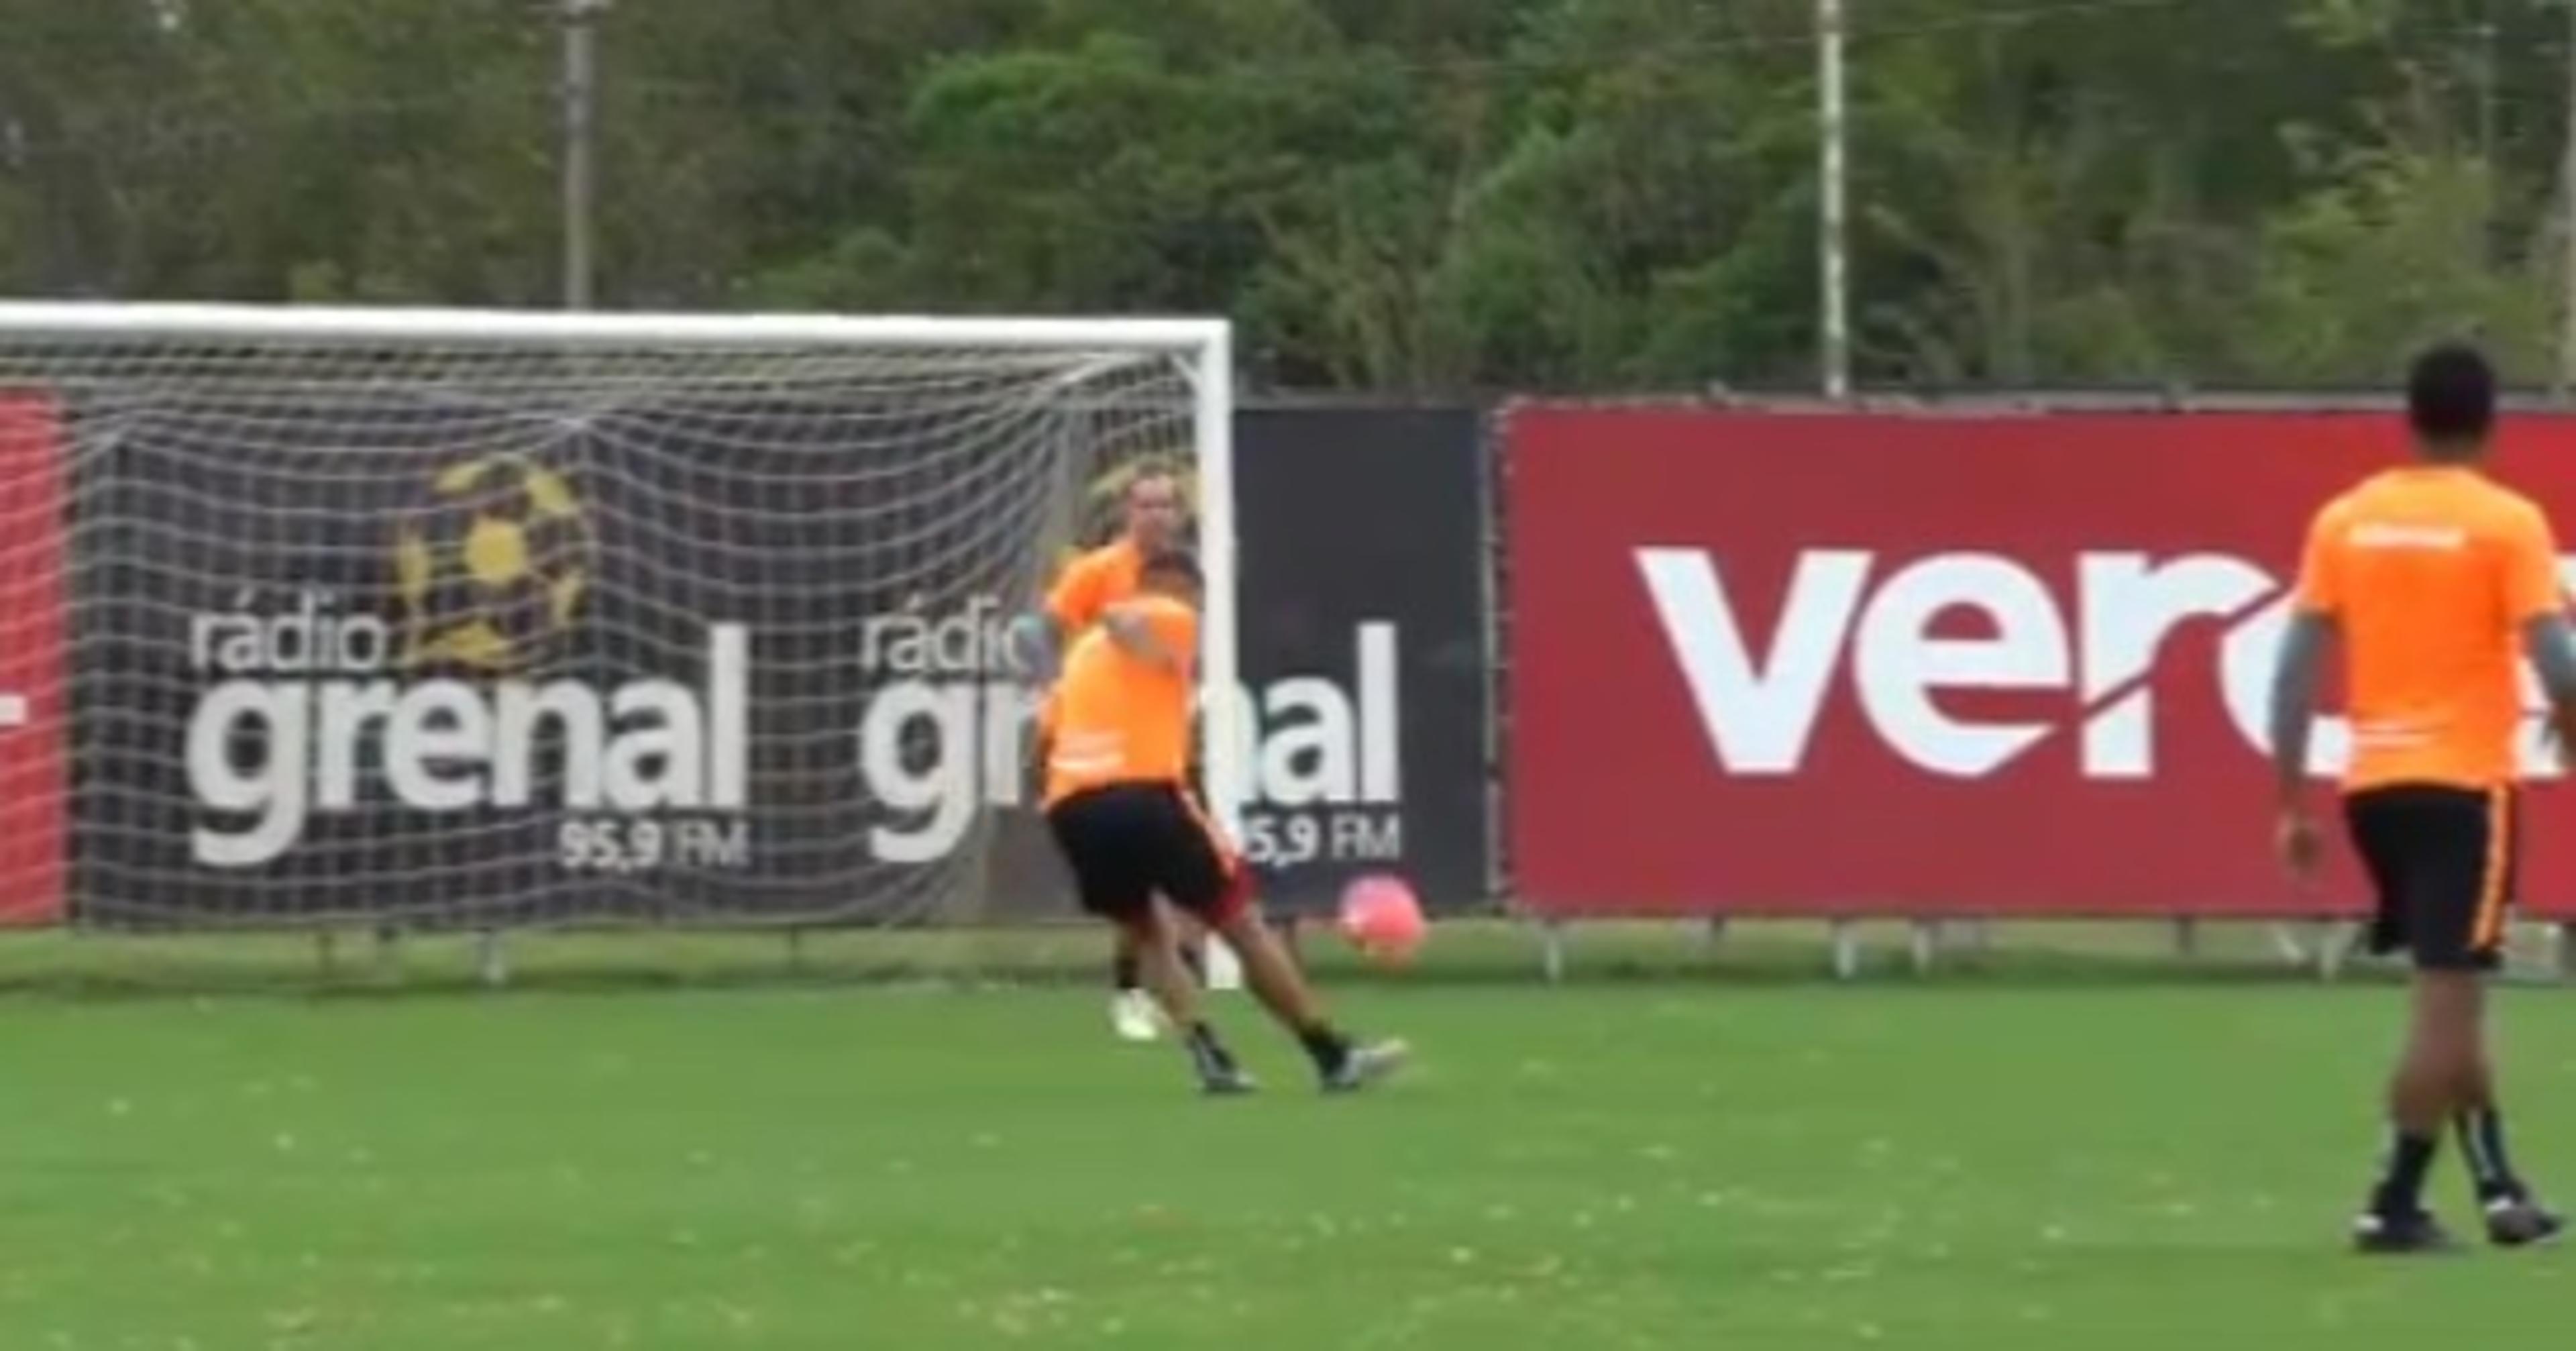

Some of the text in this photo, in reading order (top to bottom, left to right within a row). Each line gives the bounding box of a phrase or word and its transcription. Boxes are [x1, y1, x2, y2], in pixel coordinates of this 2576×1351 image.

[190, 587, 387, 671] rádio
[185, 623, 749, 866] grenal
[861, 620, 1399, 863] gral
[559, 820, 751, 875] 95,9 FM
[1238, 813, 1401, 867] 5,9 FM
